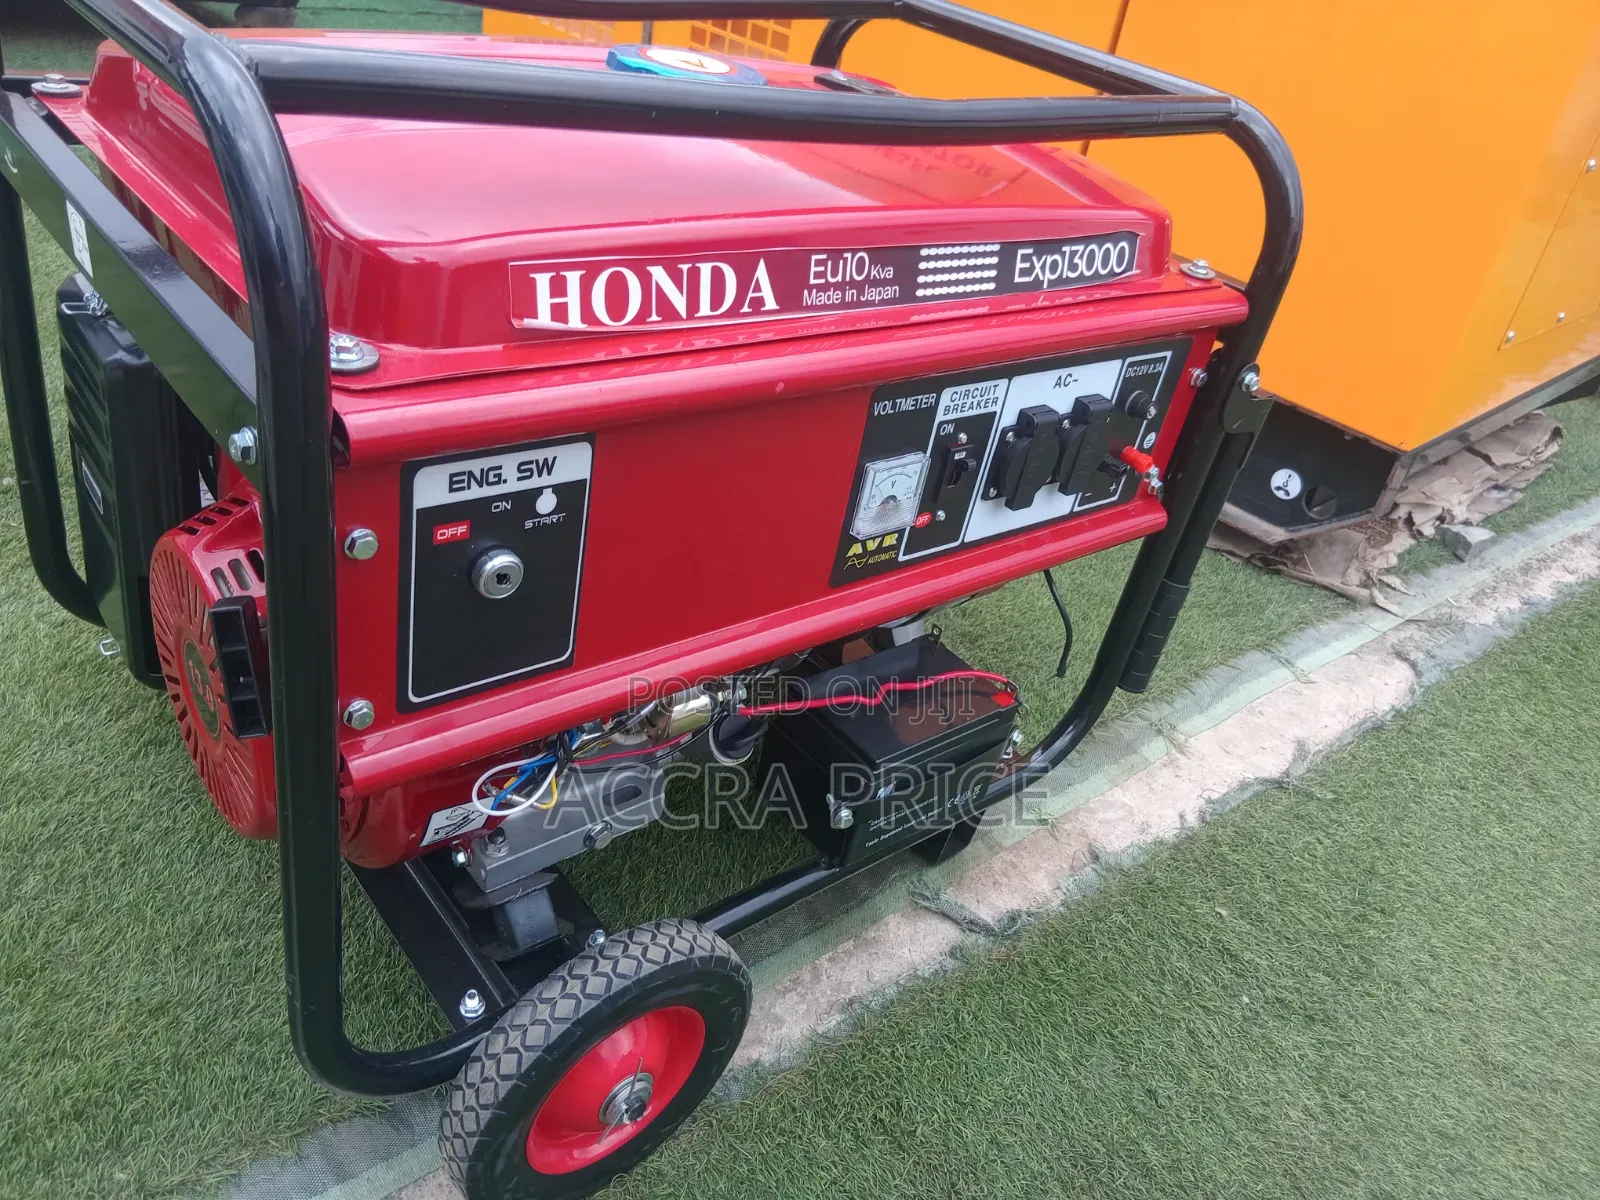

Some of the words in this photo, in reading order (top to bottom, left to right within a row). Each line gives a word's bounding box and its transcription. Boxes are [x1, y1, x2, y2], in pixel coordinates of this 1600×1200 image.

[809, 251, 870, 285] Eu10
[870, 264, 894, 281] Kva
[1013, 240, 1130, 290] Exp13000
[529, 257, 780, 329] HONDA
[802, 286, 842, 307] Made
[845, 285, 857, 303] in
[860, 284, 900, 304] Japan
[949, 384, 999, 403] CIRCUIT
[873, 392, 937, 417] VOLTMETER
[942, 397, 999, 417] BREAKER
[940, 423, 955, 436] ON
[448, 464, 508, 494] ENG.
[516, 456, 558, 482] SW
[491, 500, 512, 513] ON
[524, 512, 567, 530] START
[916, 515, 930, 526] OFF
[436, 525, 468, 540] OFF
[845, 533, 899, 558] AVR
[867, 550, 898, 565] AUTOMATIC
